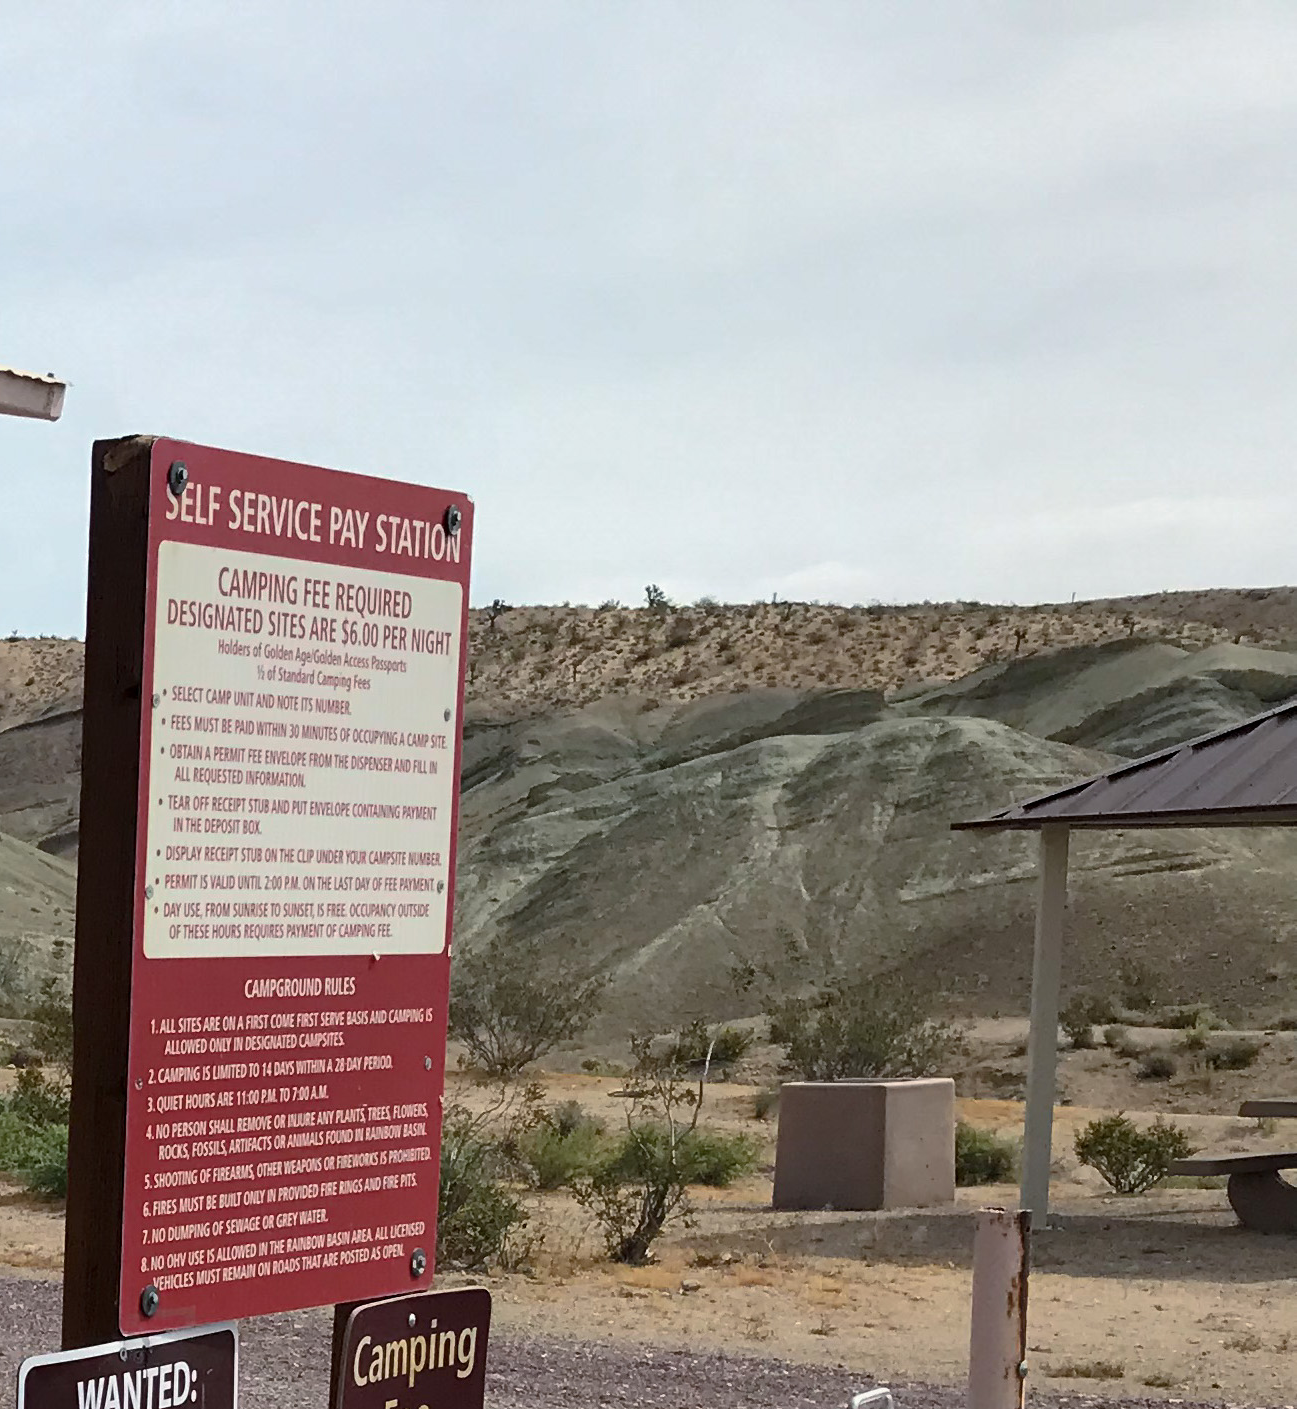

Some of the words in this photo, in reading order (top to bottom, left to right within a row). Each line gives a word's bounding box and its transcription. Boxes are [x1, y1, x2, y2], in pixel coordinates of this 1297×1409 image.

[166, 482, 221, 525] SELF
[229, 490, 322, 542] SERVICE
[330, 506, 369, 548] PAY
[376, 514, 461, 563] STATION
[219, 567, 297, 605] CAMPING
[304, 578, 330, 609] FEE
[336, 583, 412, 618] REQUIRED
[168, 599, 262, 634] DESIGNATED
[268, 611, 305, 638] SITES
[309, 616, 336, 642] ARE
[342, 618, 378, 647] $6.00
[383, 625, 406, 650] PER
[412, 628, 452, 655] NIGHT
[245, 978, 322, 998] CAMPGROUND
[325, 977, 355, 995] RULES
[354, 1319, 477, 1387] Camping
